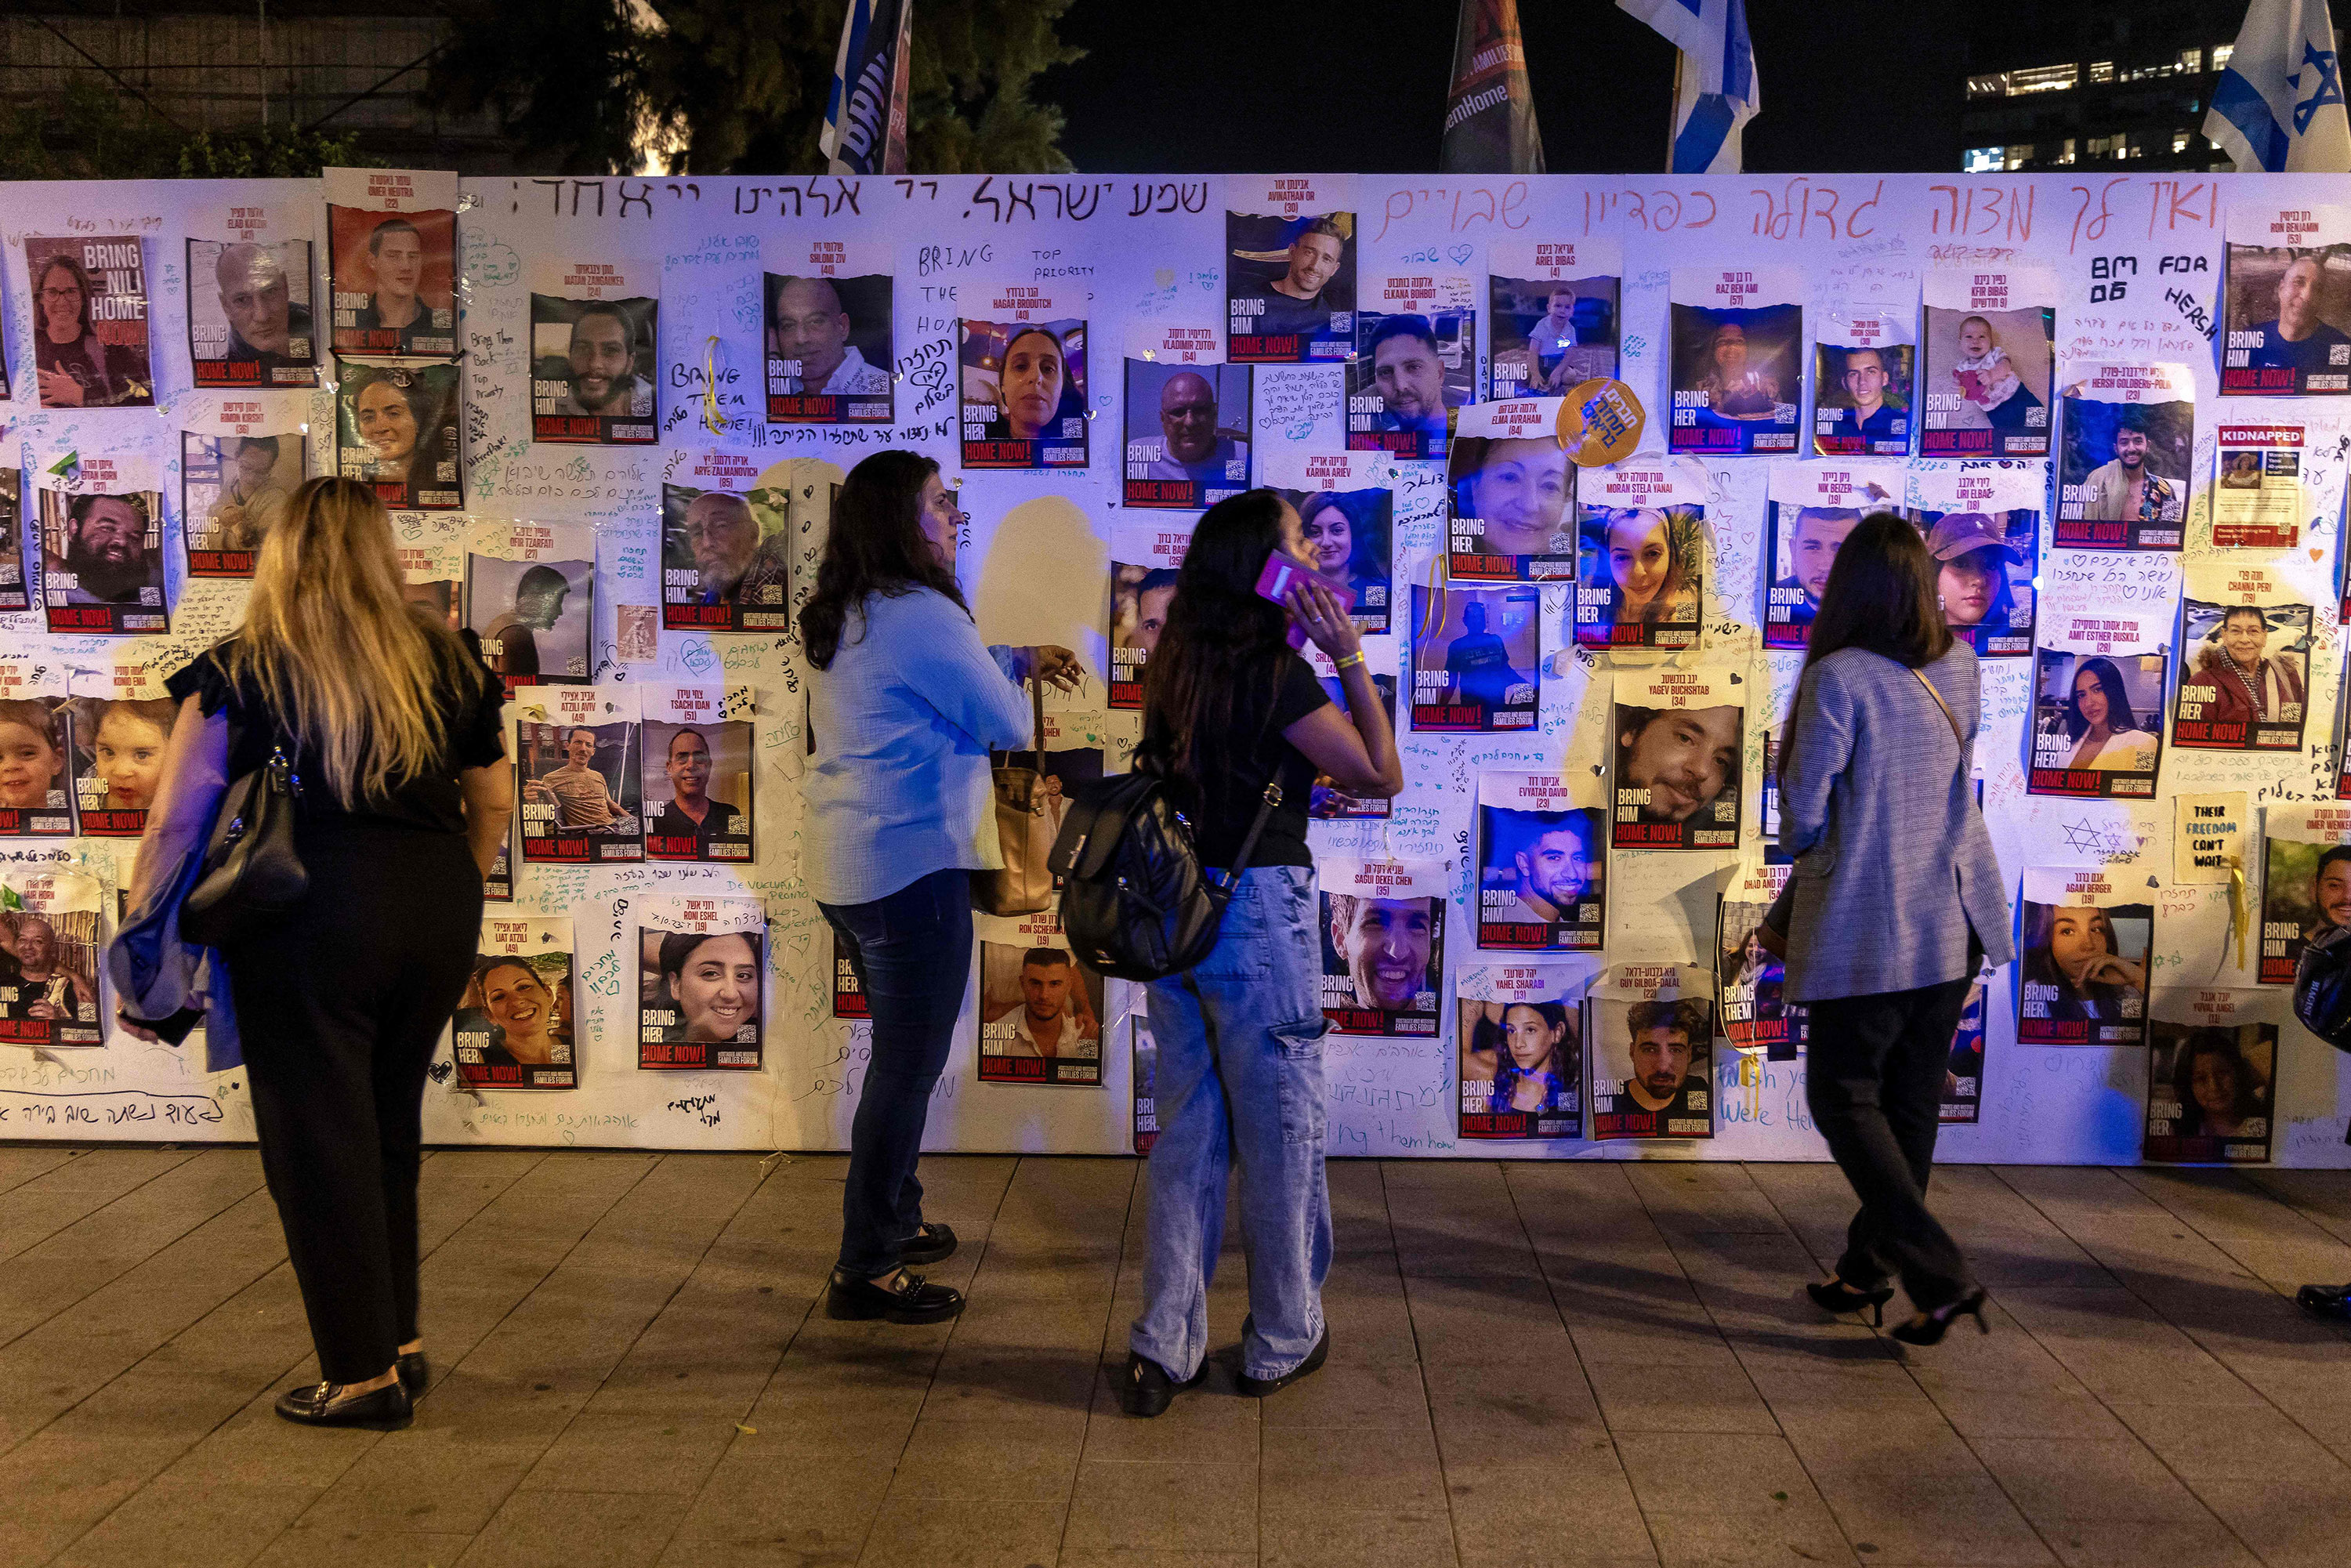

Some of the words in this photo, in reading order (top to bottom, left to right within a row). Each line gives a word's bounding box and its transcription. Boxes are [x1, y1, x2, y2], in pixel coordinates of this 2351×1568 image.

[1274, 180, 1284, 189] אור
[1288, 180, 1309, 190] אבינתן
[1128, 182, 1207, 217] שמע
[1267, 192, 1303, 201] AVINATHAN
[1306, 192, 1314, 201] OR
[2070, 178, 2128, 255] לך
[2148, 182, 2217, 241] ואין
[2271, 223, 2284, 232] RON
[2287, 223, 2319, 233] BENJAMIN
[1032, 249, 1061, 260] TOP
[1555, 244, 1574, 254] אריאל
[84, 245, 138, 269] BRING
[810, 253, 834, 263] SHLOMI
[835, 254, 846, 263] ZIV
[919, 244, 993, 277] BRING
[1536, 256, 1553, 265] ARIEL
[1556, 256, 1575, 266] BIBAS
[2160, 256, 2208, 274] FOR
[1034, 266, 1094, 281] PRIORITY
[107, 270, 142, 294] NILI
[921, 286, 957, 302] THE
[1384, 289, 1408, 299] ELKANA
[1411, 289, 1436, 299] BOHBOT
[1716, 284, 1729, 293] RAZ
[1731, 284, 1743, 293] BEN
[1745, 284, 1758, 293] AMI
[1972, 287, 1986, 296] KFIR
[1988, 287, 2008, 296] BIBAS
[334, 292, 368, 310] BRING
[993, 299, 1016, 309] HAGAR
[1018, 299, 1051, 309] BRODUTCH
[91, 298, 144, 320] HOME
[1230, 299, 1265, 316] BRING
[335, 310, 356, 328] HIM
[2165, 288, 2218, 341] HERSH
[1231, 317, 1252, 334] HIM
[97, 321, 147, 346] NOW!
[193, 325, 226, 342] BRING
[1162, 340, 1192, 350] VLADIMIR
[1194, 340, 1216, 350] ZUTOV
[1231, 337, 1262, 353] HOME
[1266, 334, 1298, 353] NOW!
[2229, 331, 2263, 348] BRING
[194, 342, 216, 359] HIM
[2226, 349, 2250, 367] HIM
[197, 362, 227, 378] HOME
[230, 360, 261, 378] NOW!
[2092, 378, 2114, 389] HERSH
[1491, 415, 1507, 424] ELMA
[1509, 414, 1541, 424] AVRAHAM
[2222, 431, 2300, 441] KIDNAPPED
[712, 466, 758, 476] ZALMANOVICH
[1306, 469, 1330, 478] KARINA
[1331, 469, 1351, 478] ARIEV
[1607, 483, 1629, 493] MORAN
[1632, 483, 1651, 493] STELA
[1654, 483, 1672, 493] YANAI
[1818, 483, 1829, 493] NIK
[1831, 483, 1852, 493] BEIZER
[2228, 581, 2255, 592] CHANNA
[2257, 582, 2271, 592] PERI
[2069, 631, 2085, 641] AMIT
[2087, 631, 2111, 641] ESTHER
[2113, 631, 2139, 643] BUSKILA
[1649, 686, 1669, 695] YAGEV
[1672, 686, 1709, 695] BUCHSHTAB
[561, 702, 579, 712] ATZILI
[581, 702, 595, 712] AVIV
[671, 701, 692, 710] TSACHI
[694, 701, 710, 710] IDAN
[2177, 722, 2209, 740] HOME
[2213, 722, 2246, 740] NOW!
[1519, 788, 1546, 797] EVYATAR
[1549, 788, 1567, 797] DAVID
[2194, 806, 2225, 817] THEIR
[2186, 823, 2237, 835] FREEDOM
[2193, 839, 2224, 850] CAN'T
[709, 849, 730, 857] FAMILIES
[732, 849, 748, 858] FORUM
[2194, 855, 2222, 867] WAIT
[1355, 875, 1374, 885] SAGUI
[1376, 875, 1394, 885] DEKEL
[1396, 876, 1412, 885] CHEN
[2066, 884, 2085, 893] AGAM
[2087, 884, 2111, 893] BERGER
[684, 911, 697, 920] RONI
[699, 911, 718, 921] ESHEL
[1020, 925, 1032, 934] RON
[2265, 922, 2299, 939] BRING
[495, 933, 507, 943] LIAT
[509, 933, 527, 942] ATZILI
[1496, 979, 1515, 989] YAHEL
[1517, 979, 1545, 989] SHARABI
[1620, 979, 1632, 987] GUY
[1634, 978, 1679, 988] GILBOA-DALAL
[1725, 985, 1755, 1002] BRING
[1725, 1003, 1751, 1020] THEM
[643, 1009, 675, 1027] BRING
[643, 1027, 662, 1042] HER
[643, 1045, 676, 1062] HOME
[679, 1045, 706, 1062] NOW!
